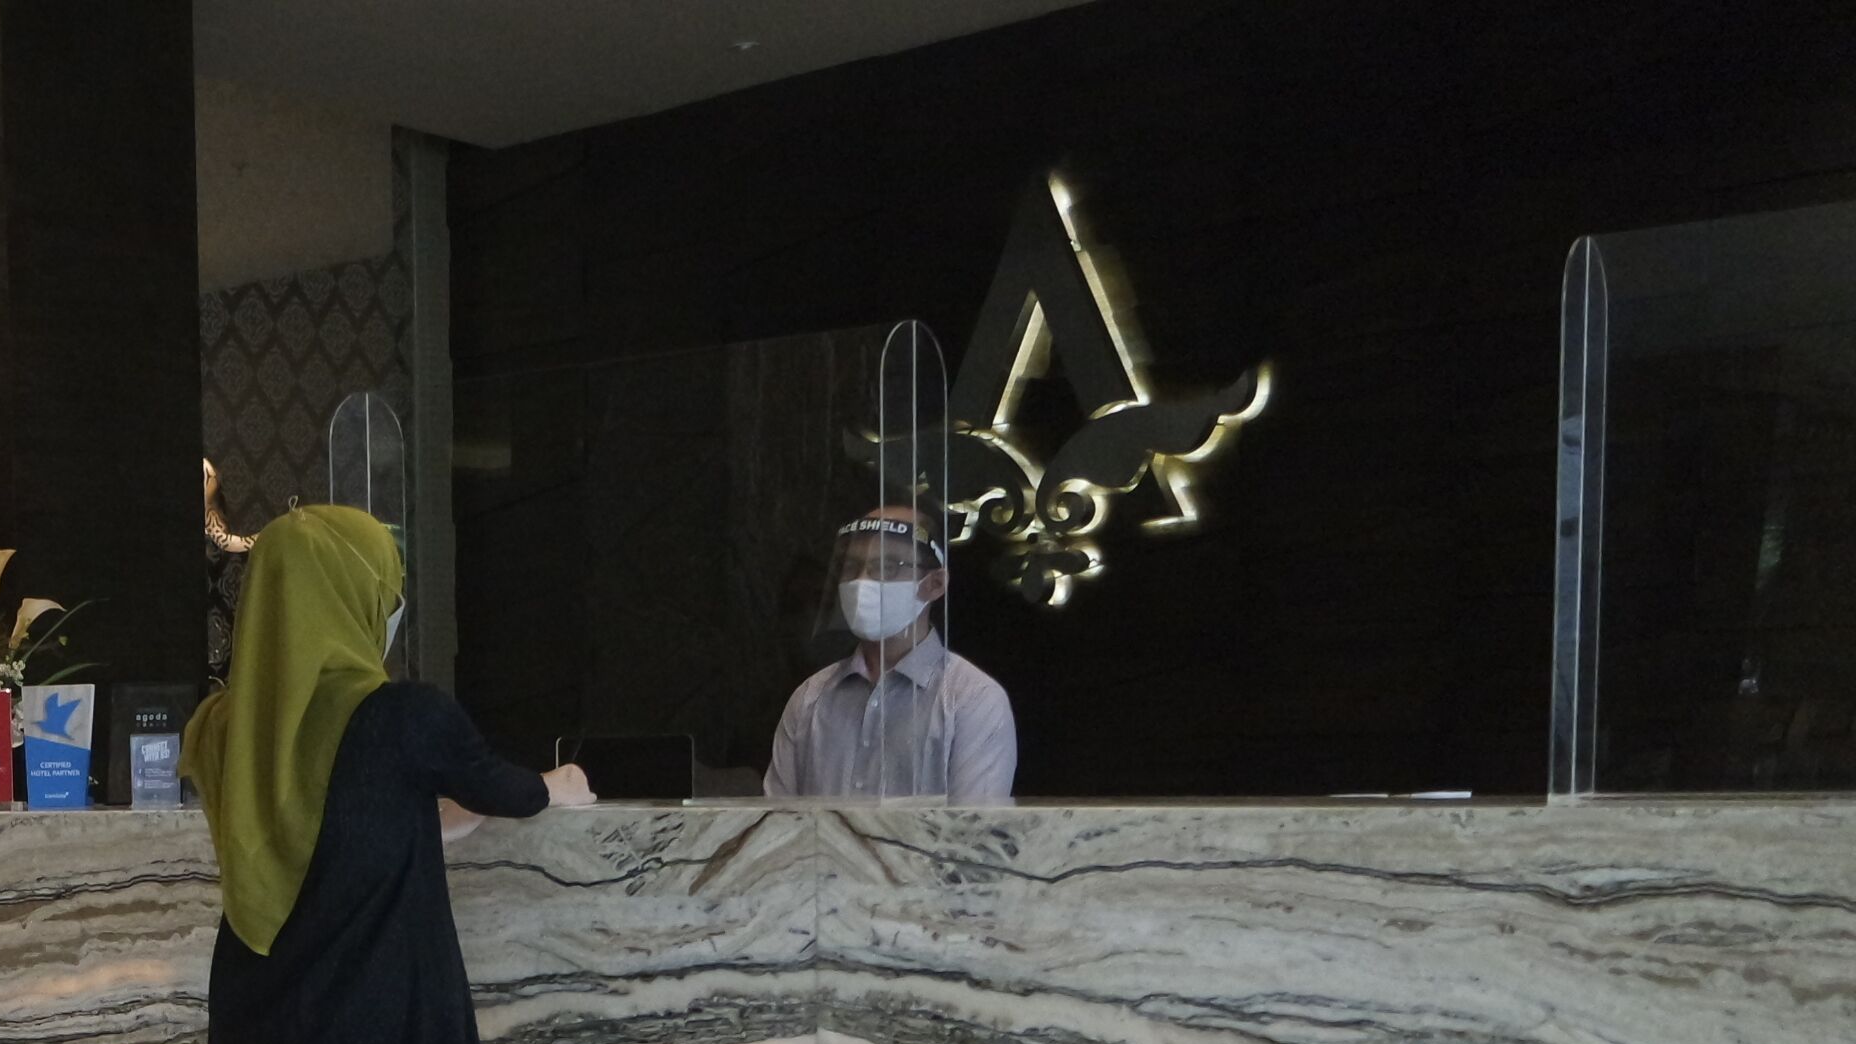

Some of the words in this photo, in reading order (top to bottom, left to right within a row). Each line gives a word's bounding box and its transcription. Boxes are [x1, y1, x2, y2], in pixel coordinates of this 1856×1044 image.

[859, 519, 908, 534] SHIELD
[136, 712, 168, 722] agoda
[39, 761, 72, 769] CERTIFIED
[30, 769, 51, 777] HOTEL
[52, 769, 81, 777] PARTNER
